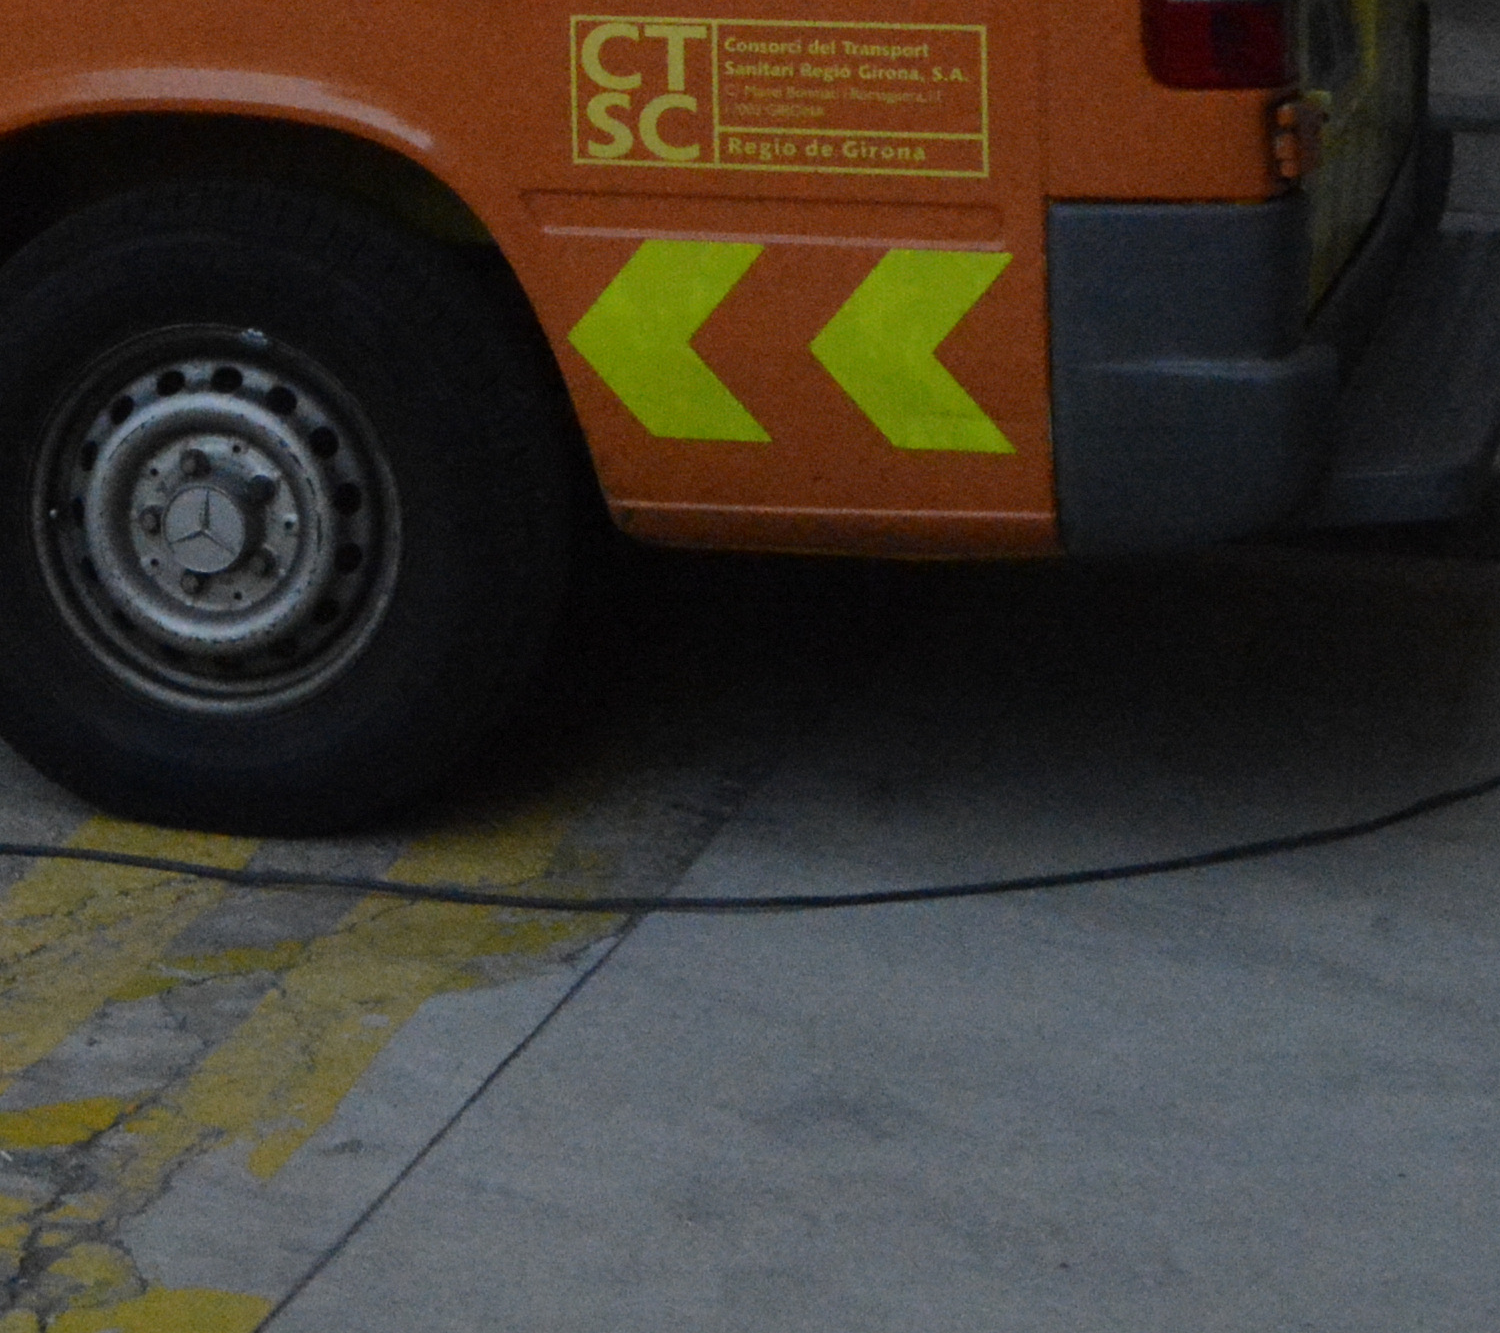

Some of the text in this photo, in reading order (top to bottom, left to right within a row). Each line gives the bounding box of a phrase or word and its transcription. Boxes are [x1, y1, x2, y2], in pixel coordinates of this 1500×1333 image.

[580, 21, 708, 91] CT
[724, 36, 930, 60] Consorci del Transport
[586, 91, 701, 162] SC
[805, 138, 834, 158] de
[842, 140, 926, 162] Girona
